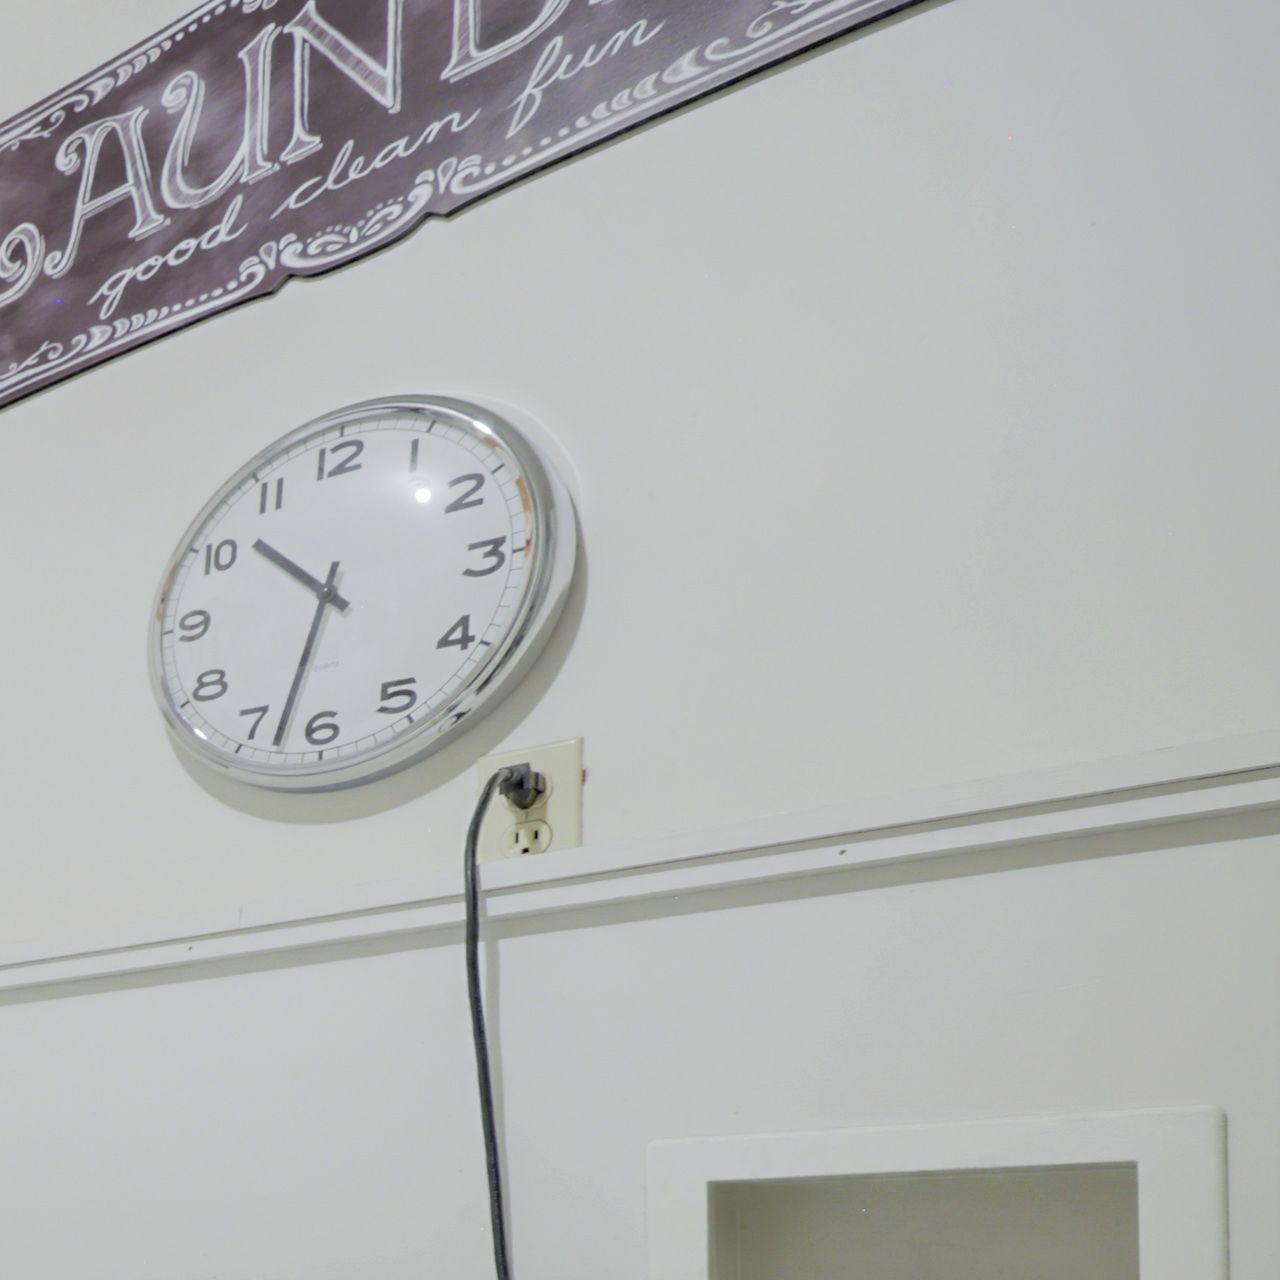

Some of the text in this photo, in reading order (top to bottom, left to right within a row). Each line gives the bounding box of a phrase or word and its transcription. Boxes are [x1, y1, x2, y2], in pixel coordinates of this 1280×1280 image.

[88, 18, 667, 318] good clean fun
[316, 438, 365, 482] 12
[409, 437, 420, 473] 1
[259, 476, 285, 515] 11
[444, 472, 486, 514] 2
[203, 538, 238, 576] 10
[461, 535, 508, 578] 3
[178, 609, 212, 643] 9
[435, 614, 476, 651] 4
[191, 668, 229, 702] 8
[375, 677, 418, 715] 5
[239, 704, 270, 741] 7
[304, 710, 341, 746] 6
